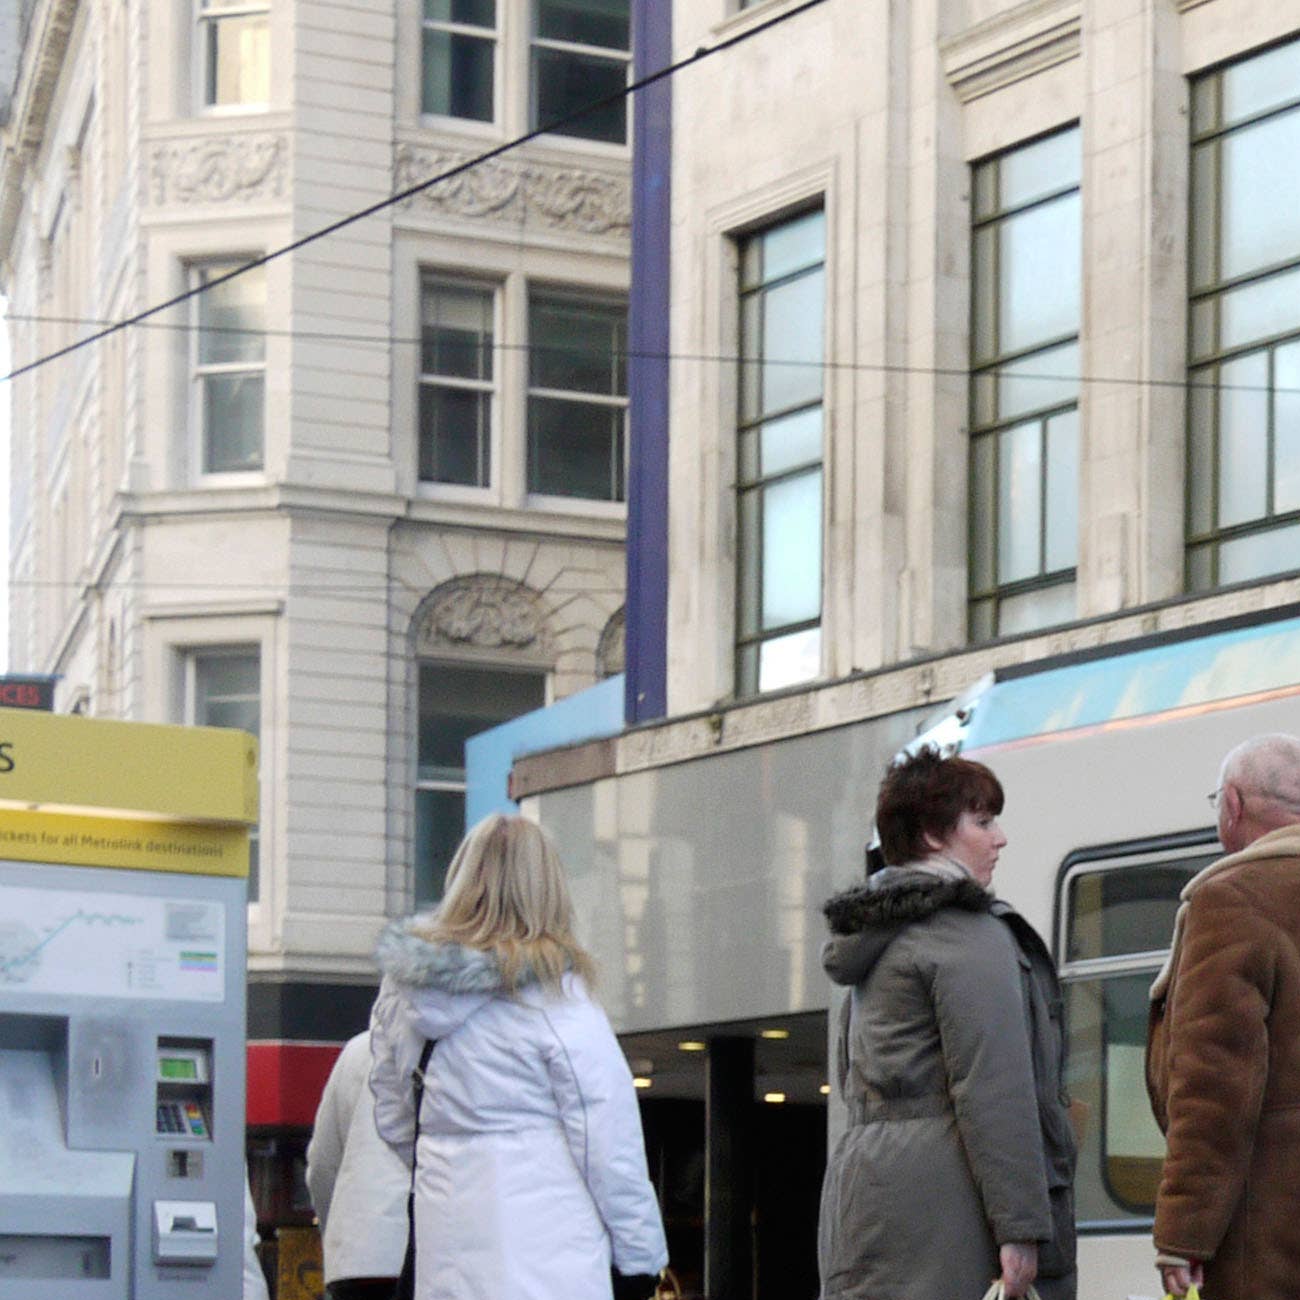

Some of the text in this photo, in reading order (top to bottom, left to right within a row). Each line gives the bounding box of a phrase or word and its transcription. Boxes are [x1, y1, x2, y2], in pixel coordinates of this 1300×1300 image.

[41, 831, 58, 846] for
[63, 834, 78, 848] all
[81, 835, 141, 852] Metrolink
[145, 841, 224, 858] destinations
